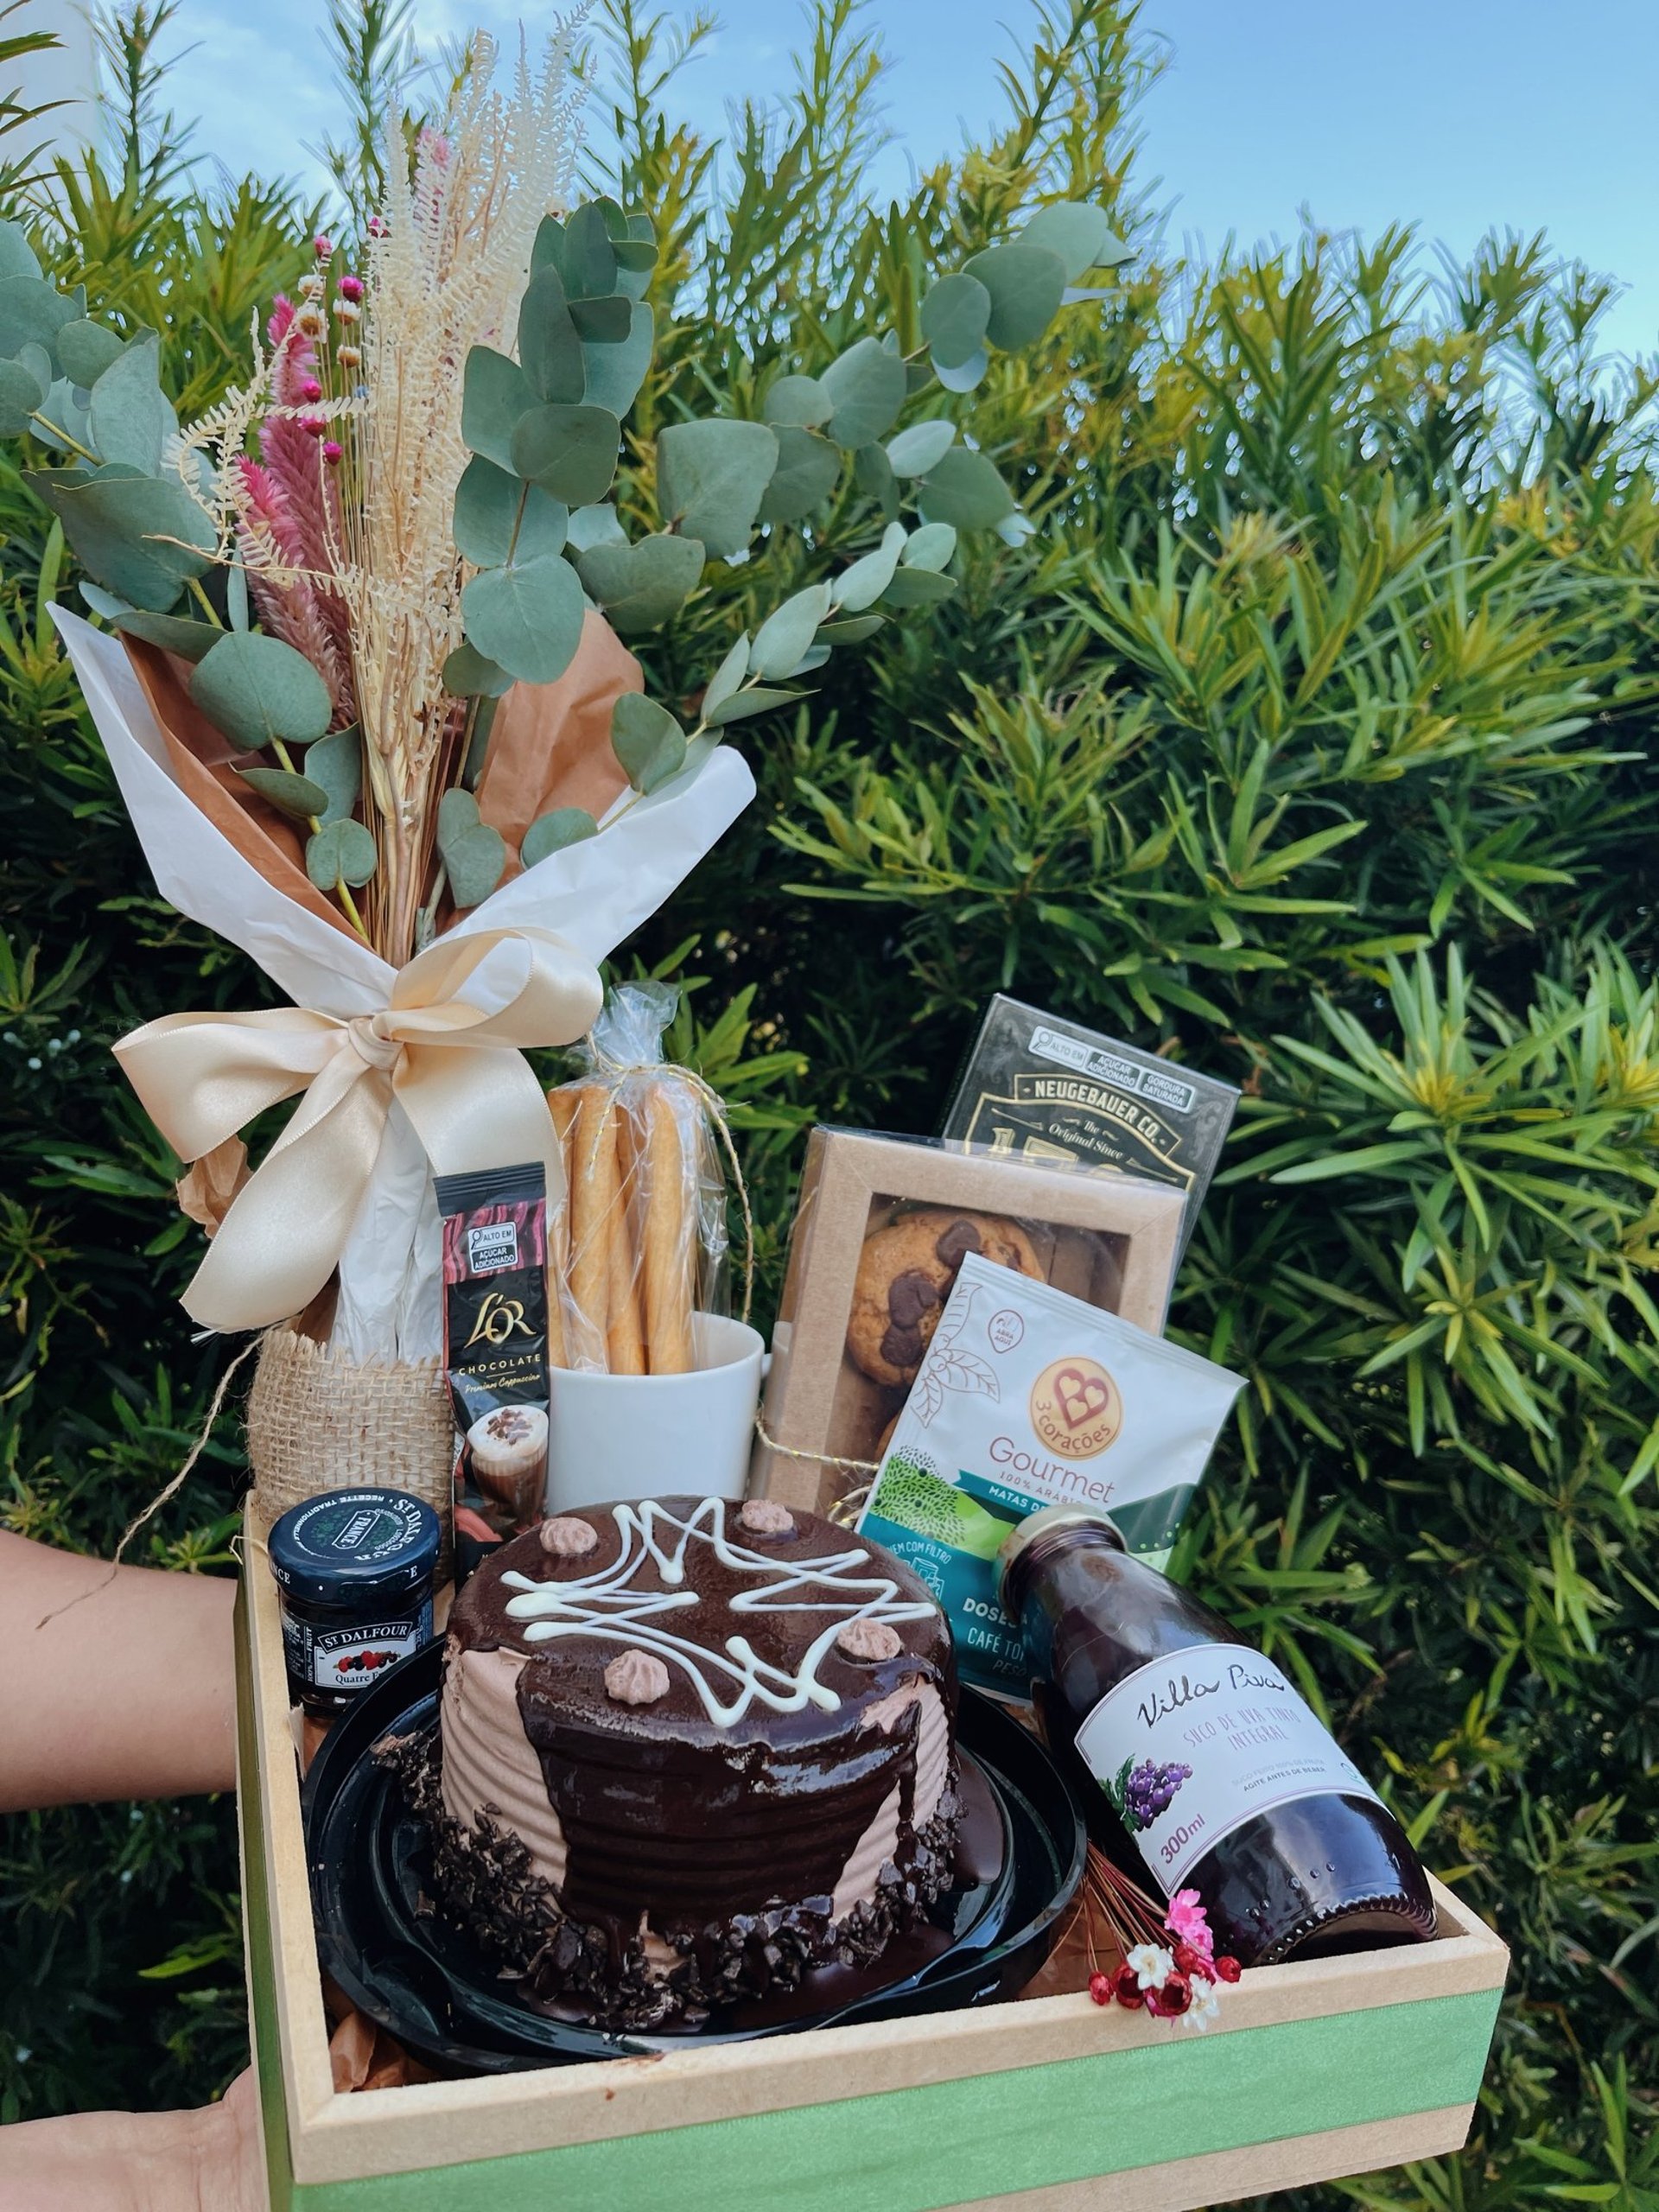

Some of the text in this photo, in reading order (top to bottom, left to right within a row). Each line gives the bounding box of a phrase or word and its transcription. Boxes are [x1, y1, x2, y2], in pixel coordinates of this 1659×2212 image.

[1050, 1042, 1084, 1060] ALTO EM
[1087, 1062, 1135, 1087] ADICIONADO
[1147, 1075, 1186, 1096] GORDURA
[1142, 1083, 1185, 1107] SATURADA
[1034, 1080, 1160, 1143] NEUGEBAUER CO.
[1084, 1120, 1100, 1135] The
[1049, 1122, 1095, 1149] Original
[1093, 1140, 1123, 1160] Since
[483, 1230, 512, 1242] ALTO EM
[474, 1254, 515, 1269] ADICIONADO
[464, 1292, 537, 1349] L'OR
[458, 1353, 541, 1376] CHOCOLATE
[465, 1373, 541, 1395] Premium Cappuccino
[1035, 1399, 1111, 1454] 3 corações
[989, 1436, 1115, 1503] Gourmet
[999, 1471, 1031, 1491] 100%
[339, 1494, 385, 1503] RECETTE
[988, 1485, 1029, 1508] MATAS
[340, 1516, 372, 1545] FRANCE
[906, 1541, 925, 1553] COM
[925, 1542, 951, 1565] FILTRO
[963, 1597, 1017, 1629] DOSE
[340, 1624, 408, 1643] DALFOUR
[967, 1627, 1002, 1654] CAFÉ
[334, 1673, 370, 1685] Quatre
[1136, 1675, 1220, 1729] Villa
[1183, 1721, 1217, 1748] SUCO
[1217, 1713, 1237, 1732] DE
[1238, 1706, 1267, 1725] UVA
[1226, 1724, 1290, 1751] INTEGRAL
[1243, 1778, 1266, 1792] AGITE
[1266, 1769, 1291, 1783] ANTES
[1291, 1767, 1303, 1776] DE
[1160, 1813, 1205, 1865] 300ml
